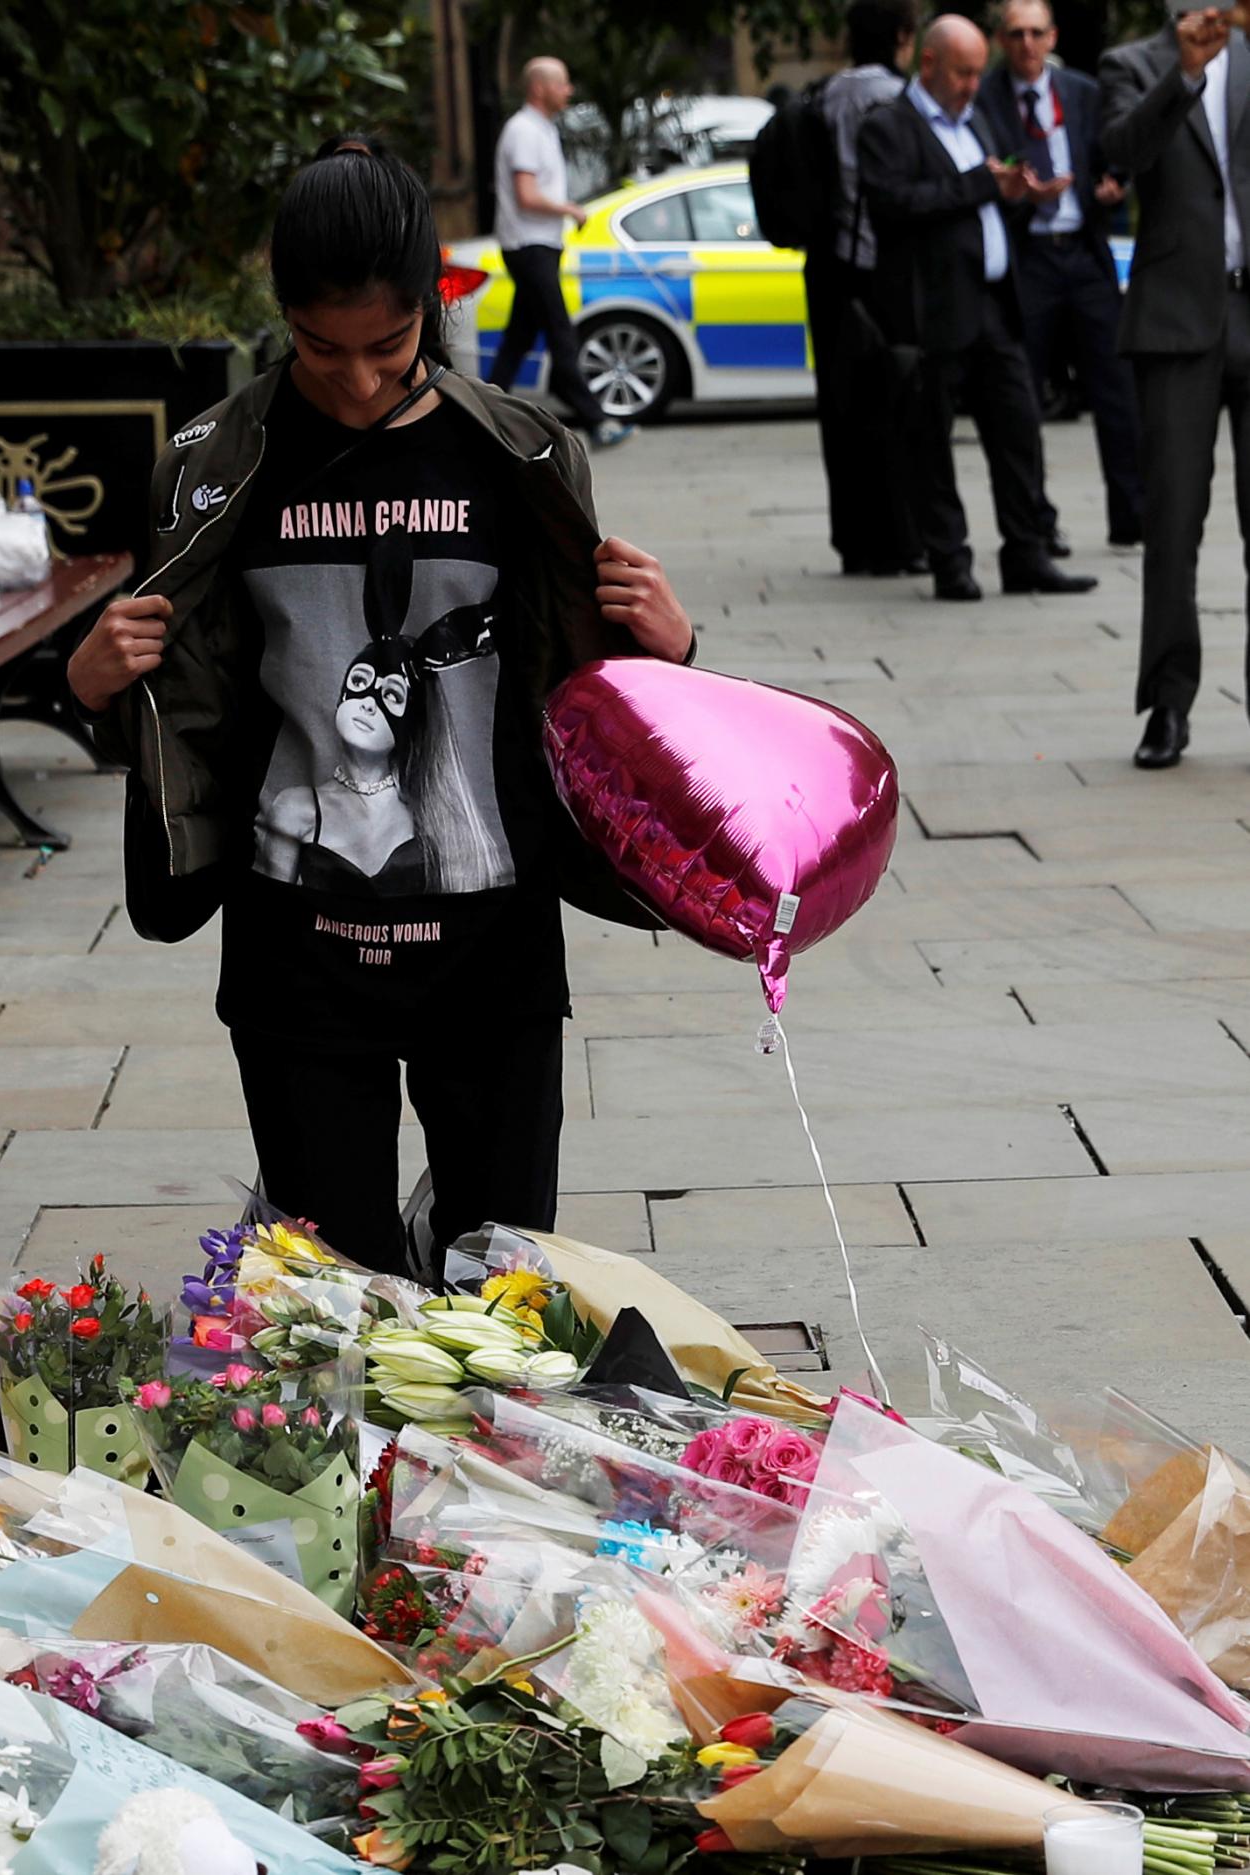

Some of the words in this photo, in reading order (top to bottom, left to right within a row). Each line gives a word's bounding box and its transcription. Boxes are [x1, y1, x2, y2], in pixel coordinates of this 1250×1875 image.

[280, 501, 367, 539] ARIANA
[375, 499, 470, 536] GRANDE
[315, 914, 389, 943] DANGEROUS
[393, 922, 441, 942] WOMAN
[359, 947, 392, 965] TOUR
